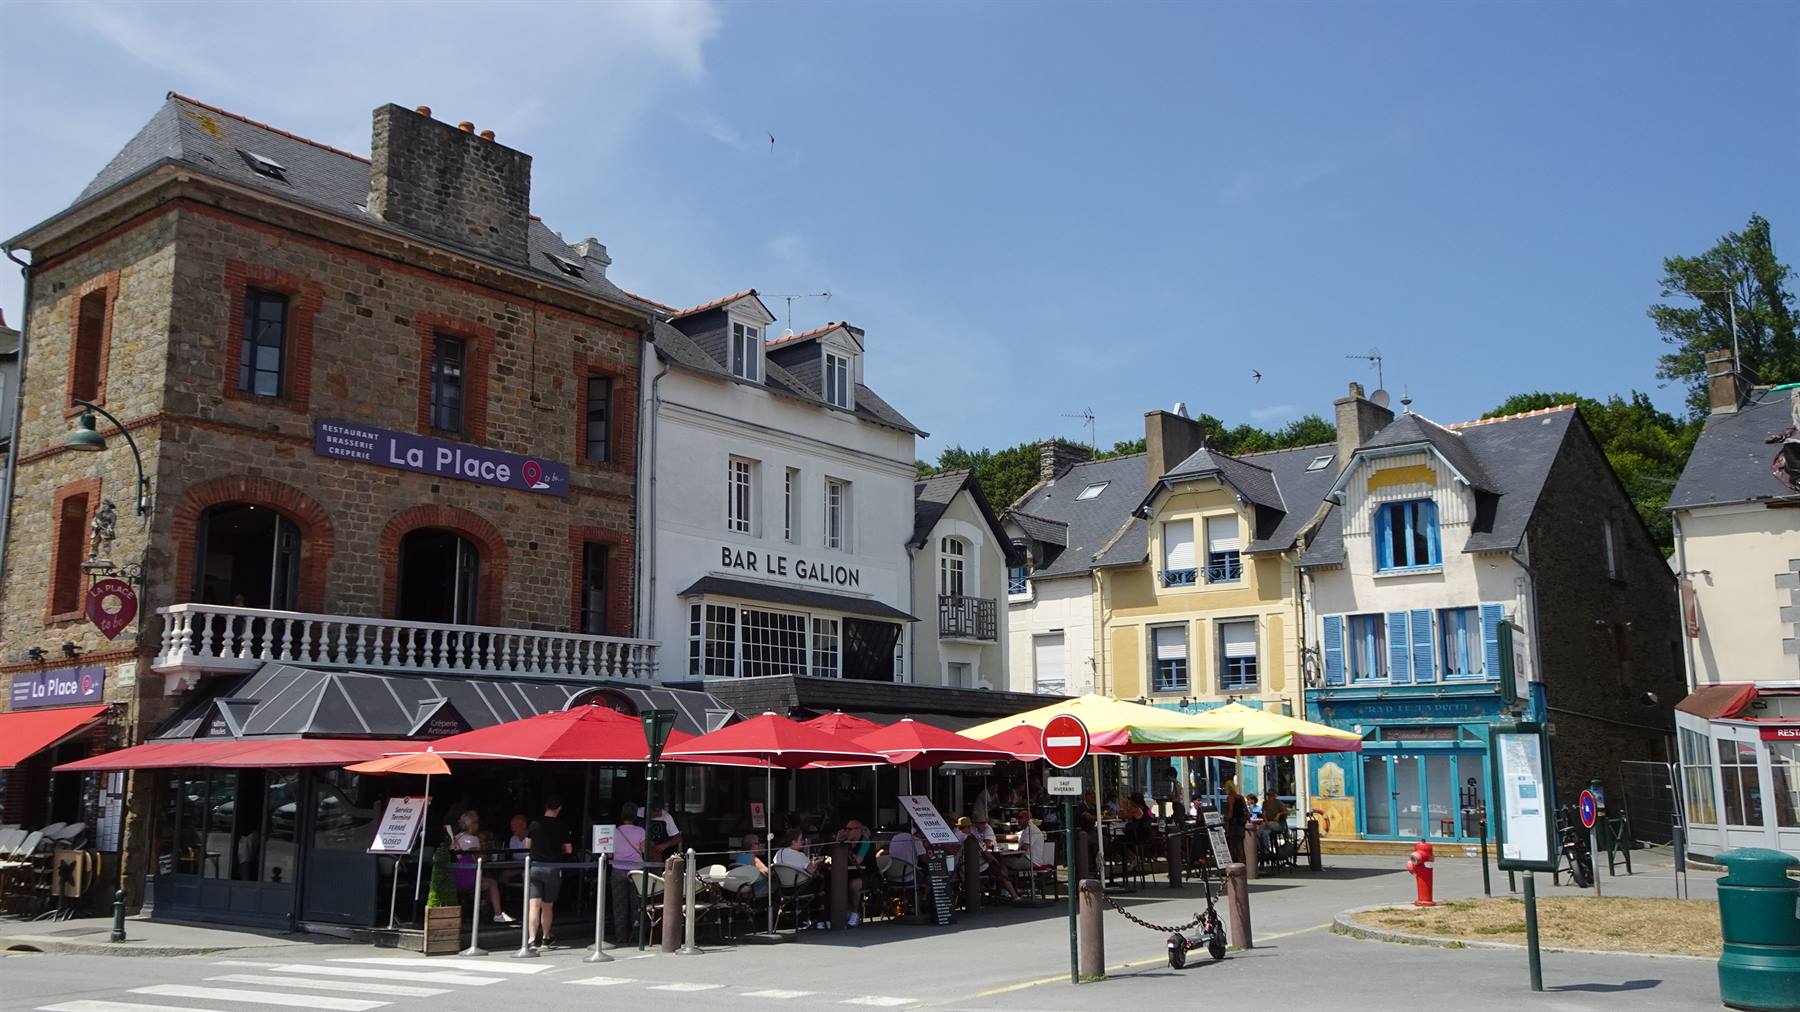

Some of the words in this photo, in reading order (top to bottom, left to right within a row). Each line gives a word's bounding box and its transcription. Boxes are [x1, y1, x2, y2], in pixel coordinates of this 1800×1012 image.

[322, 424, 379, 440] RESTAURANT
[326, 435, 374, 450] BRASSERIE
[328, 446, 370, 460] CREPERIE
[389, 438, 424, 468] La
[436, 447, 511, 482] Place
[721, 546, 758, 572] BAR
[767, 554, 787, 576] LE
[795, 559, 860, 587] GALION
[91, 587, 104, 597] LA
[105, 584, 134, 600] PLACE
[32, 681, 45, 698] La
[48, 677, 78, 697] Place
[1777, 728, 1800, 737] REST
